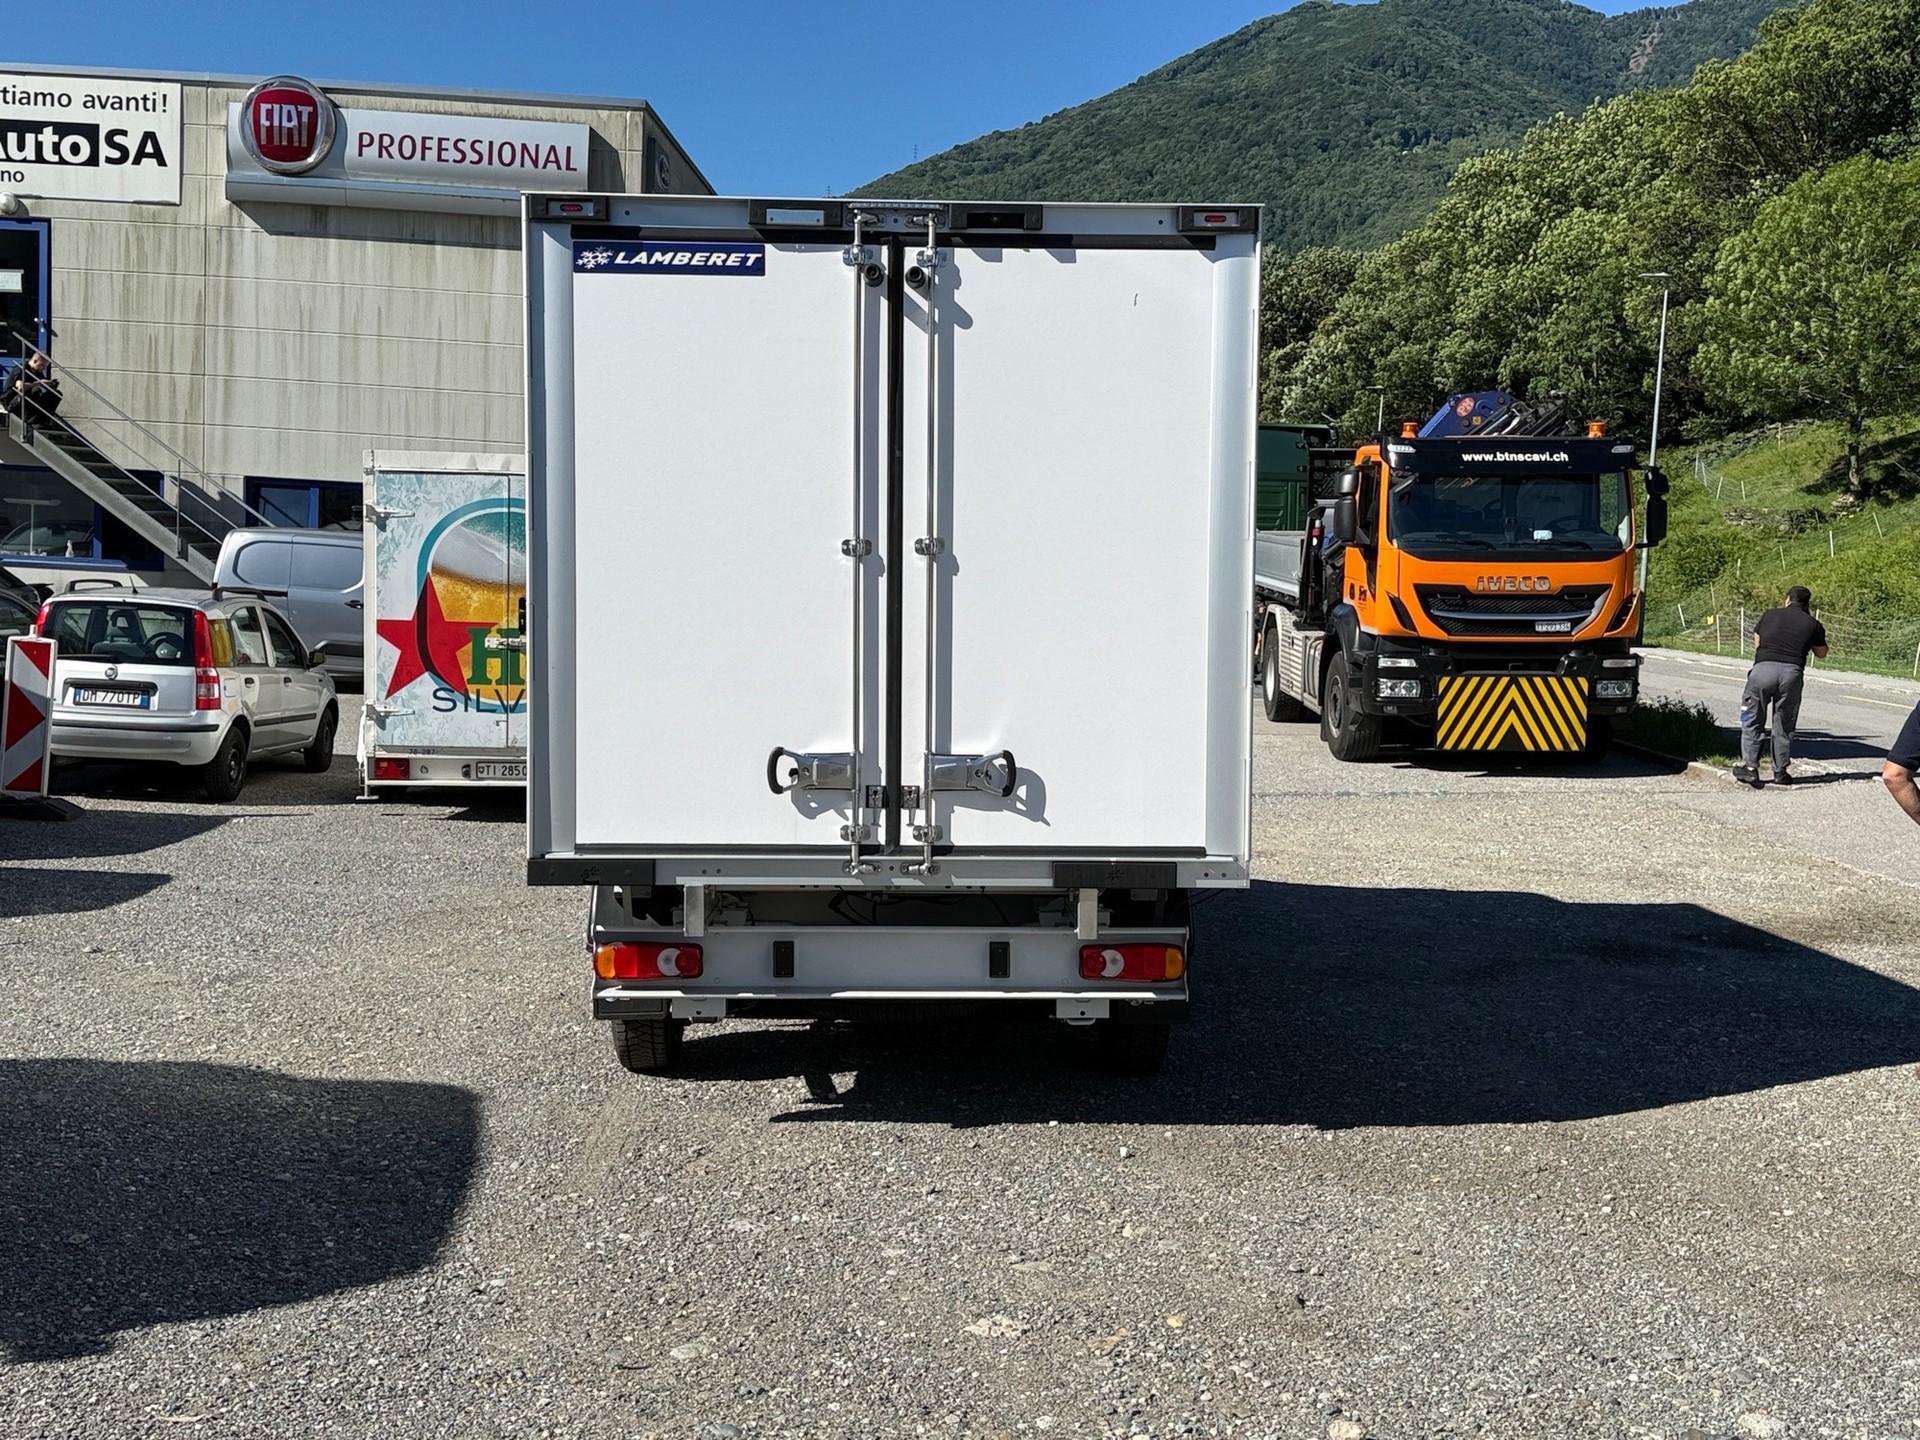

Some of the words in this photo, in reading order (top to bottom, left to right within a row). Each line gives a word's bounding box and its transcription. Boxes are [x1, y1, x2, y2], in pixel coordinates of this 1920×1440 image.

[82, 92, 168, 114] avanti!
[259, 102, 314, 148] FIAT
[357, 131, 578, 172] PROFESSIONAL
[104, 128, 168, 168] SA
[614, 251, 762, 267] LAMBERET
[1461, 451, 1569, 462] www.btnscavi.ch
[1476, 575, 1551, 592] IVECO
[432, 687, 526, 713] SILV
[485, 765, 496, 776] TI
